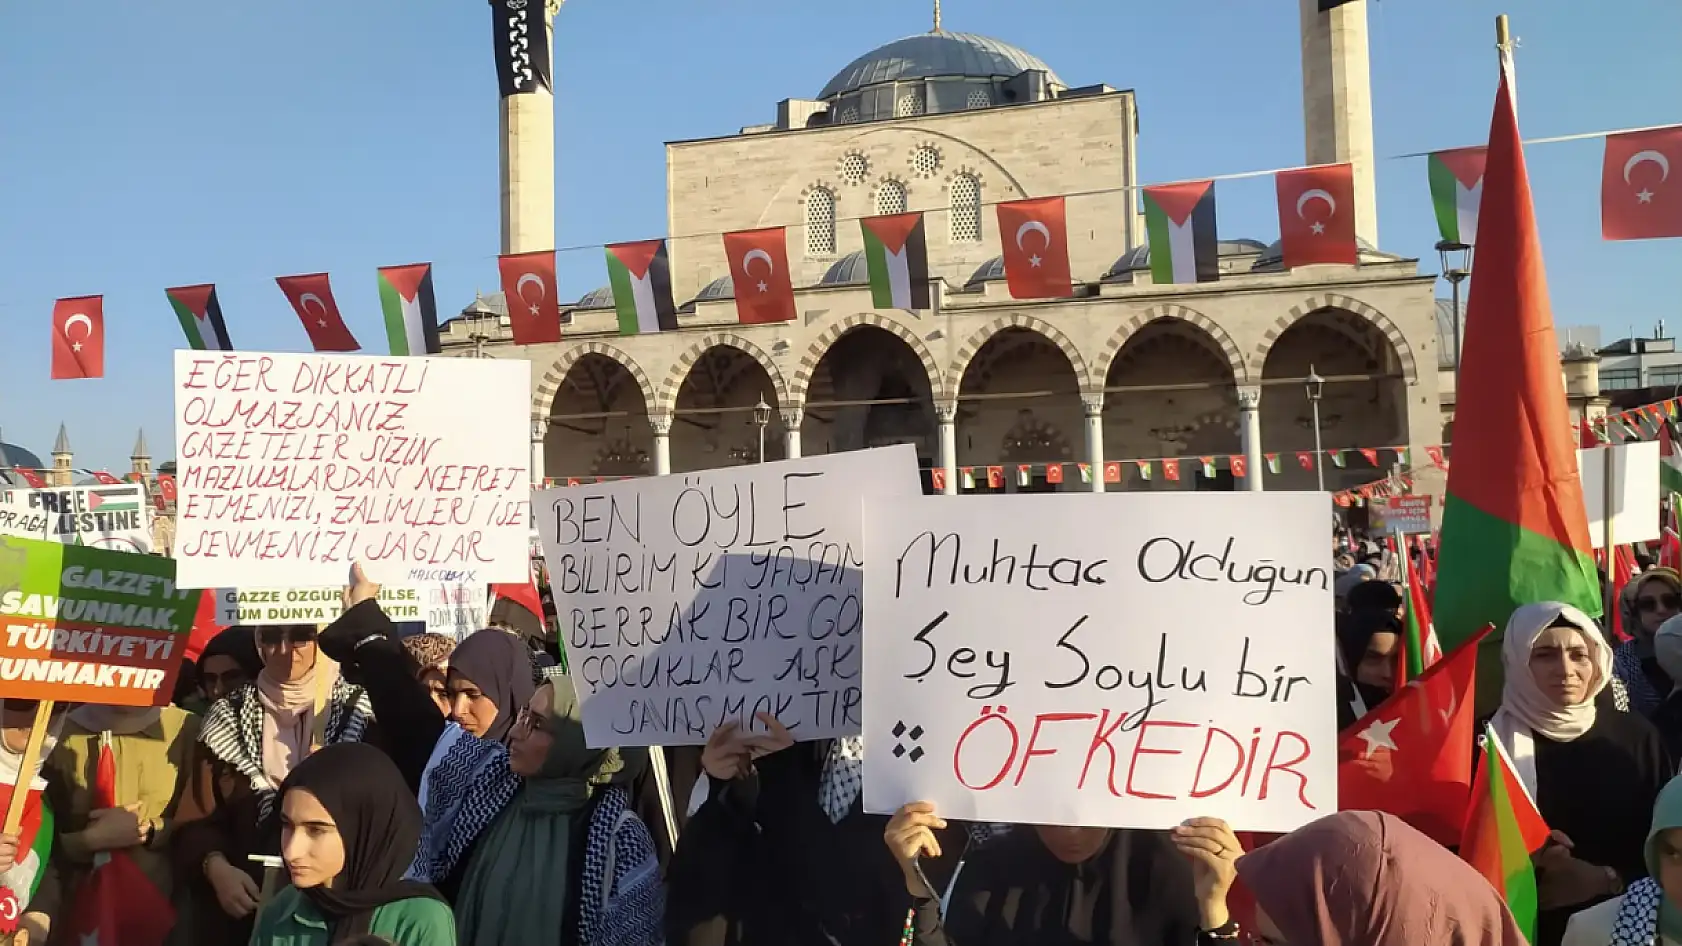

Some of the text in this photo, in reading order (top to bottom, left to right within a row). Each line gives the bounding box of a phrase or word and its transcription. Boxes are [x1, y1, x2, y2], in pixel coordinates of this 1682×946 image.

[183, 355, 430, 395] EĞER DİKKATLİ
[182, 432, 442, 464] GAZETELER SİZİN
[182, 465, 526, 492] MAZLUMLARDAN NEFRET
[29, 490, 86, 513] FREE
[331, 494, 479, 526] ZALİMLERİ
[487, 494, 530, 526] İSE
[552, 472, 825, 548] BEN ÖYLE
[183, 527, 359, 563] SEVMENİZİ
[561, 544, 677, 595] BİLİRİM
[692, 549, 728, 589] Kİ
[1137, 537, 1328, 605] Olduğun
[1, 591, 179, 631] SAVUNMAK,
[225, 591, 280, 604] GAZZE
[287, 587, 342, 603] ÖZGÜR
[225, 606, 261, 620] TÜM
[267, 606, 325, 620] DÜNYA
[571, 588, 863, 648] BERRAK BİR GÖ
[6, 623, 175, 660] TÜRKİYE'Yİ
[582, 648, 755, 694] ÇOCUKLAR
[903, 611, 1312, 731] Şey Soylu bir
[954, 704, 1316, 810] ÖFKEDİR
